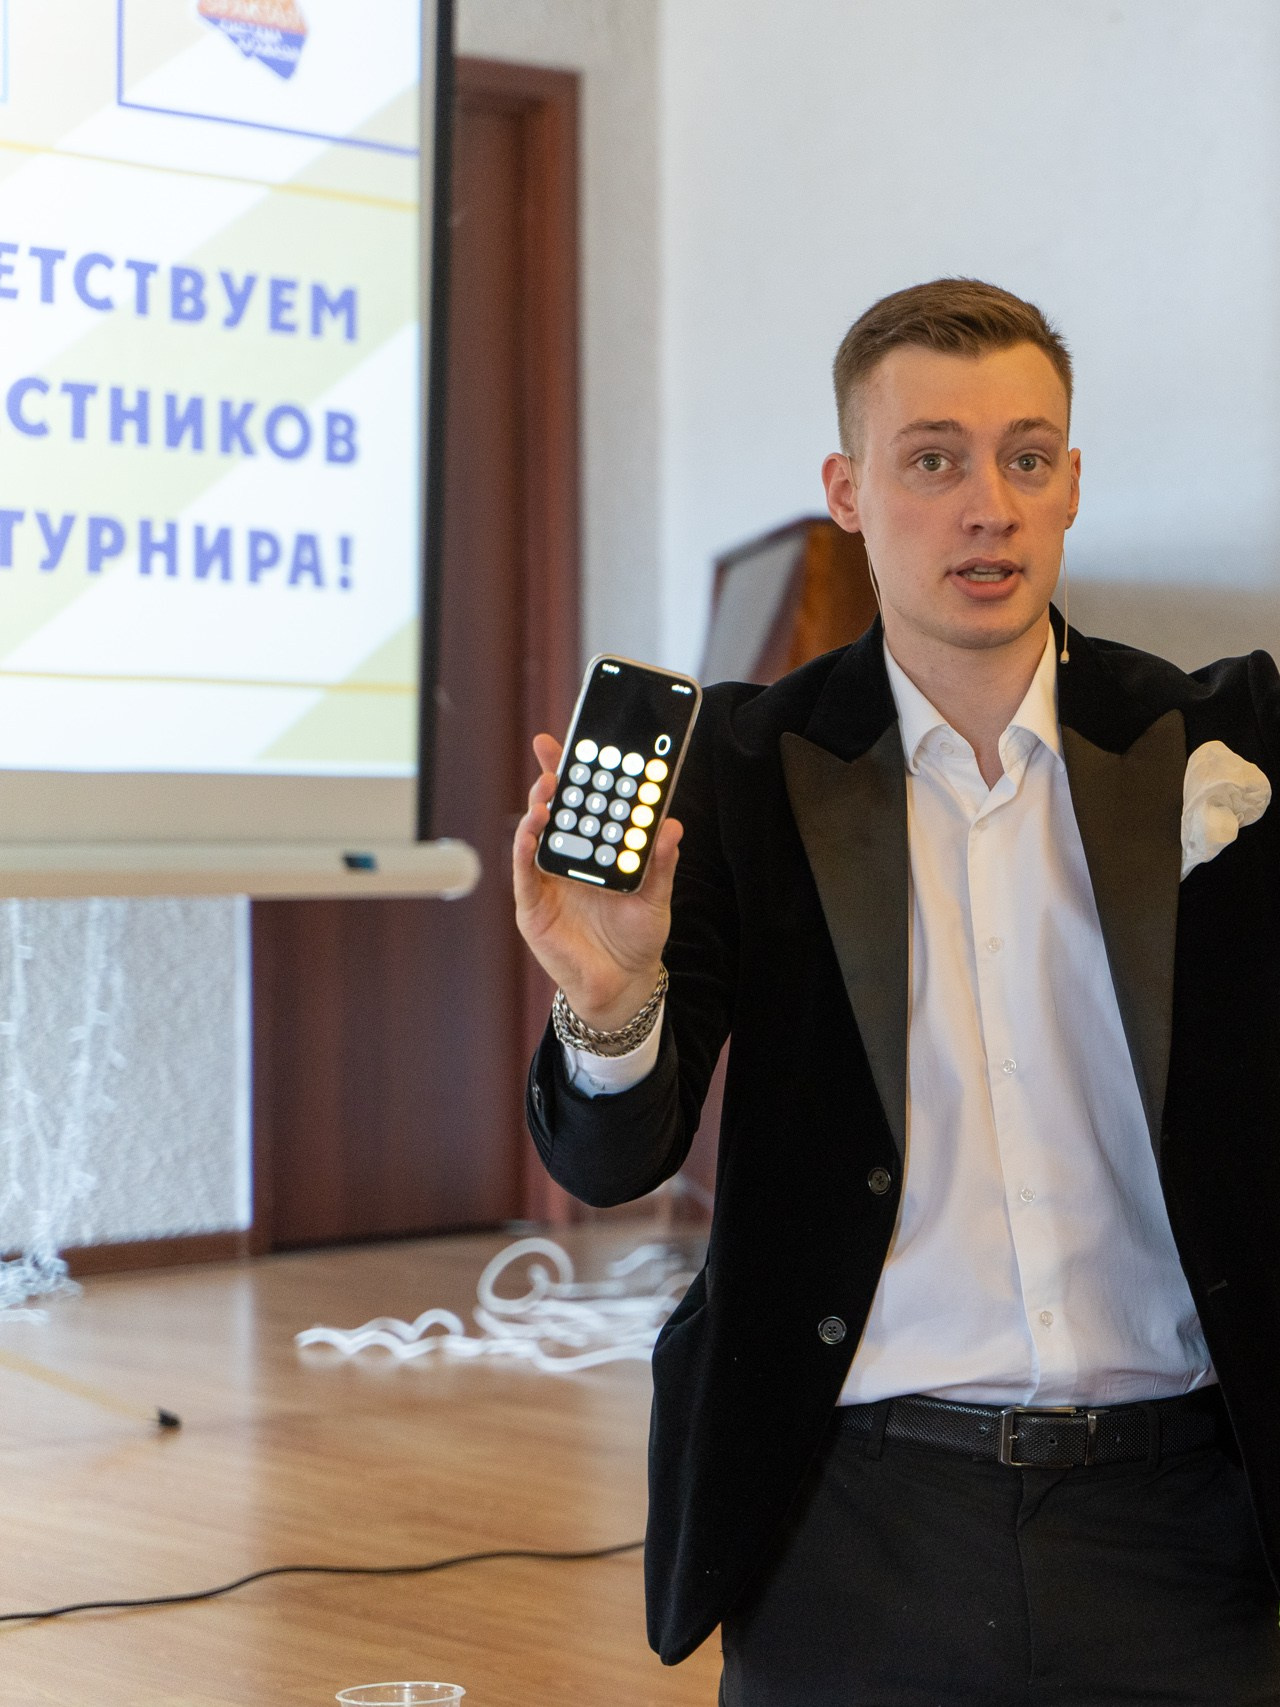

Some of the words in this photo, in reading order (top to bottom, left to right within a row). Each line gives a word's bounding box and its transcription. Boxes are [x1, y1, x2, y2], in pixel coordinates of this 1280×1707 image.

[0, 243, 358, 342] ЕТСТВУЕМ
[5, 376, 359, 465] СТНИКОВ
[0, 509, 353, 591] ТУРНИРА!
